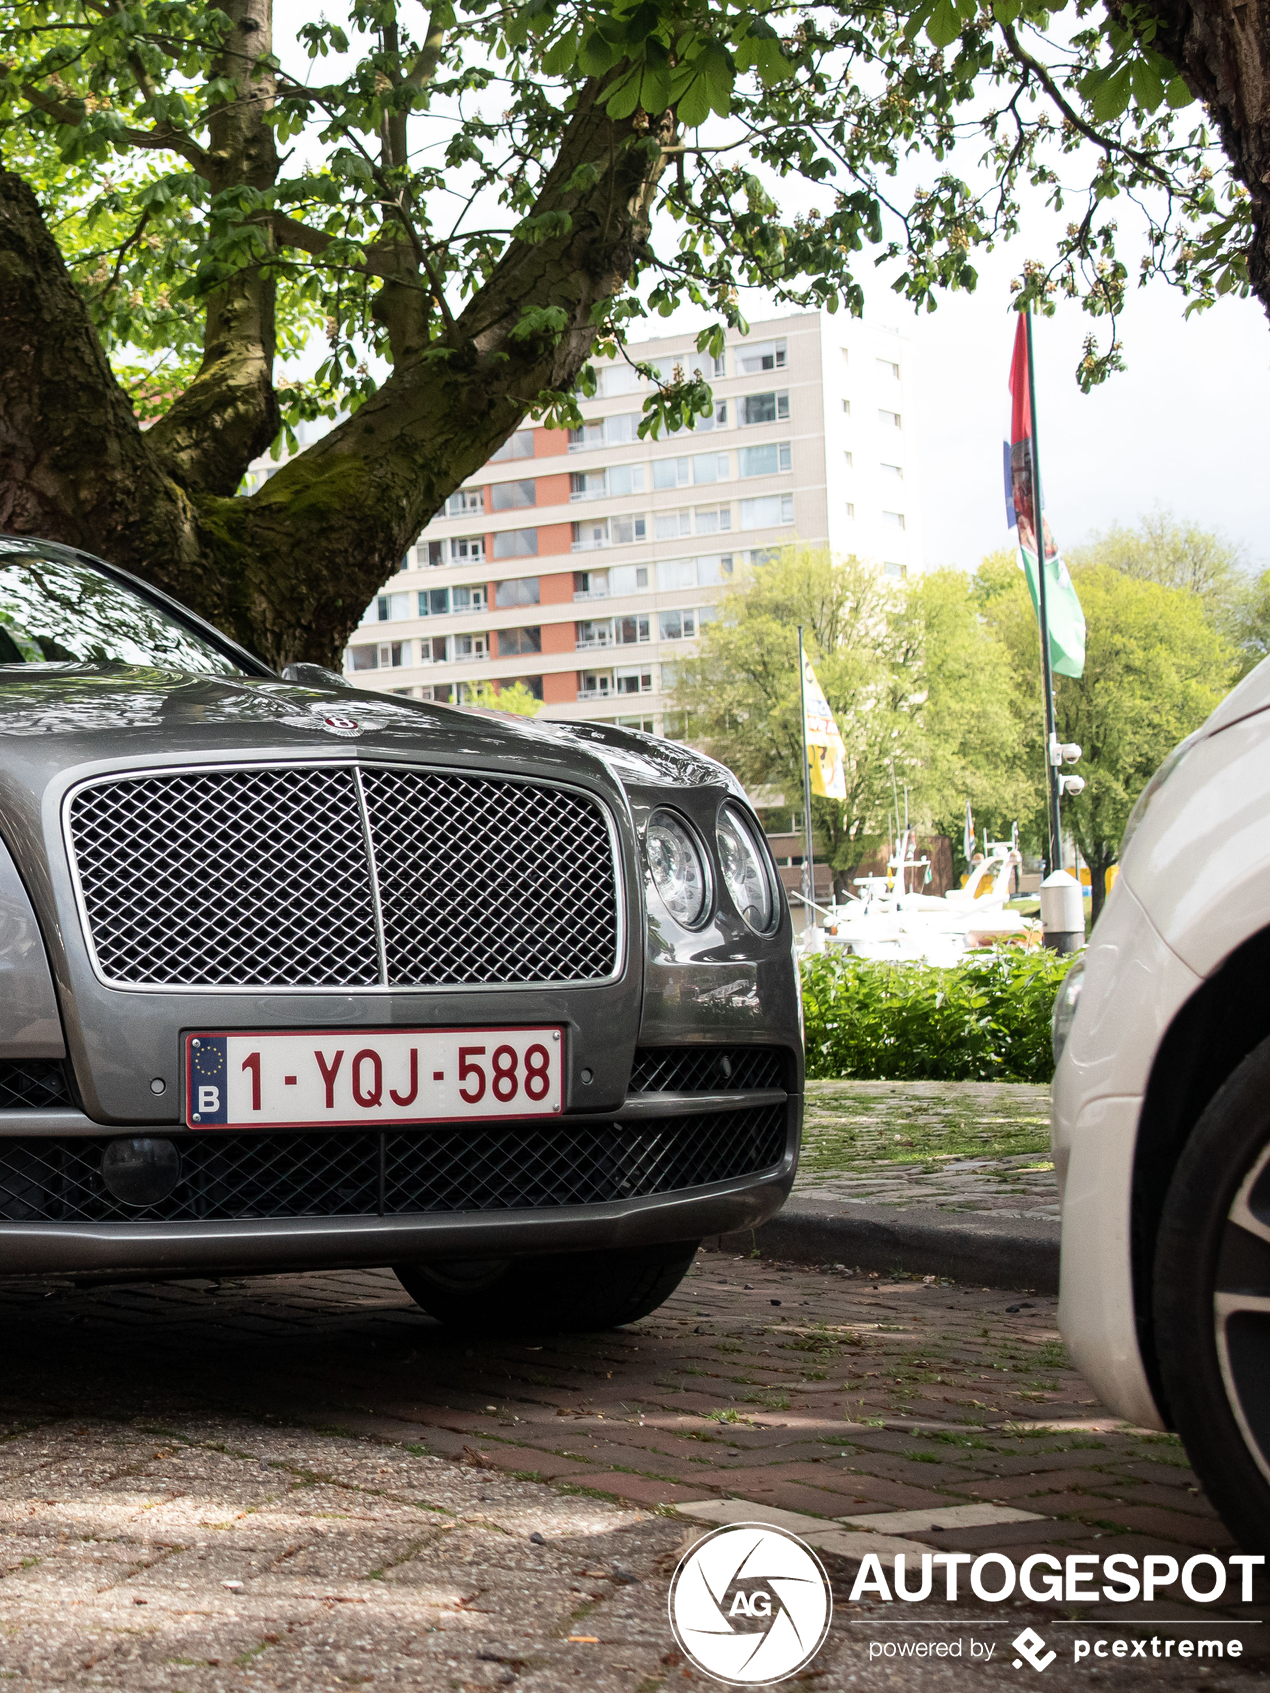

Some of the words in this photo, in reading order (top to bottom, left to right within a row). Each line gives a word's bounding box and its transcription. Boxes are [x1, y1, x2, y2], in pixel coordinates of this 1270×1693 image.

[330, 717, 354, 728] B
[241, 1043, 550, 1111] 1-YQJ-588
[198, 1085, 220, 1113] B
